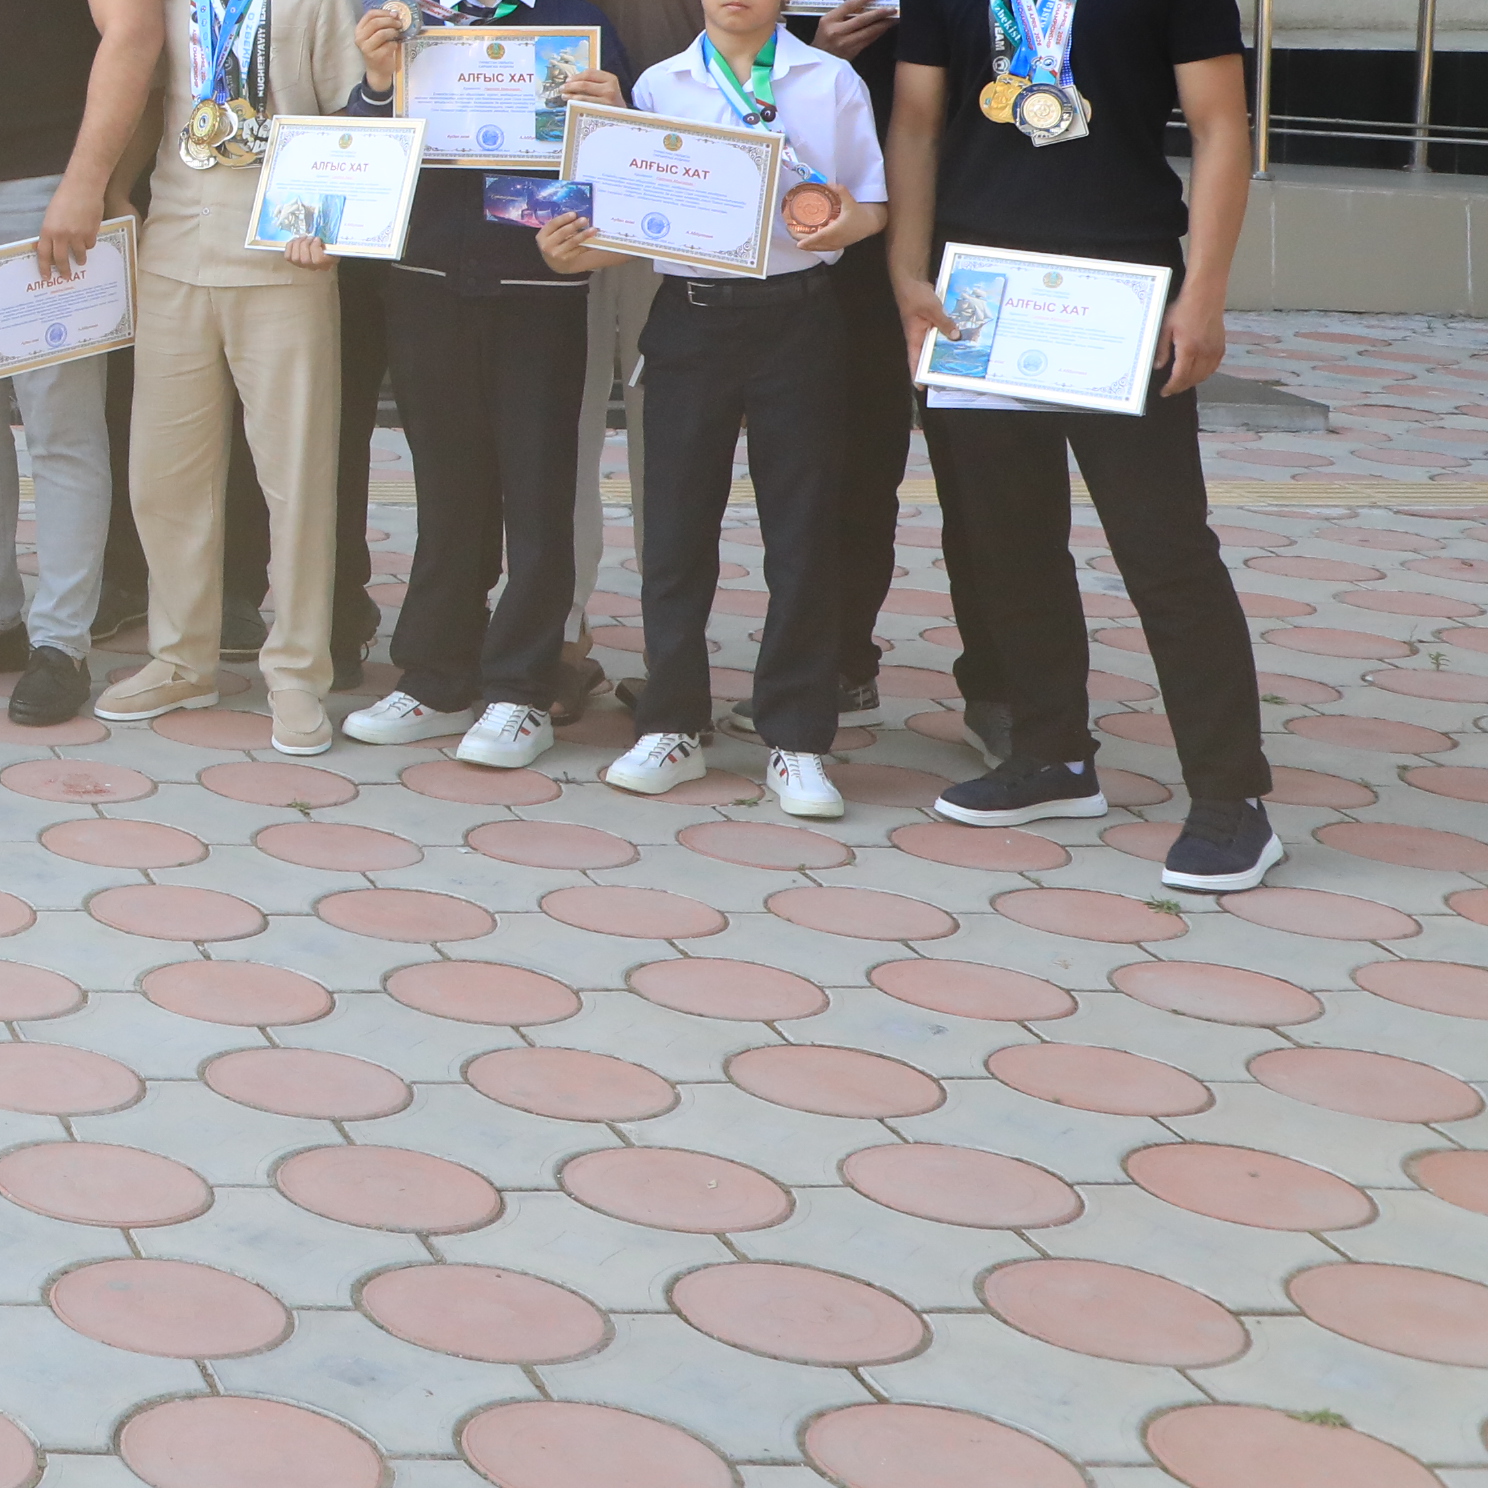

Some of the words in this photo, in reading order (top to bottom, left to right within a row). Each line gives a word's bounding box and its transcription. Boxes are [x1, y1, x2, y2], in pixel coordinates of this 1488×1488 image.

[257, 28, 266, 97] KUCHERYAVIY
[458, 73, 504, 83] АЛҒЫС
[509, 73, 534, 83] ХАТ
[349, 163, 368, 172] ХАТ
[629, 158, 679, 175] АЛҒЫС
[682, 167, 710, 180] ХАТ
[26, 276, 63, 292] АЛҒЫС
[1004, 298, 1056, 312] АЛҒЫС
[1060, 304, 1089, 316] ХАТ
